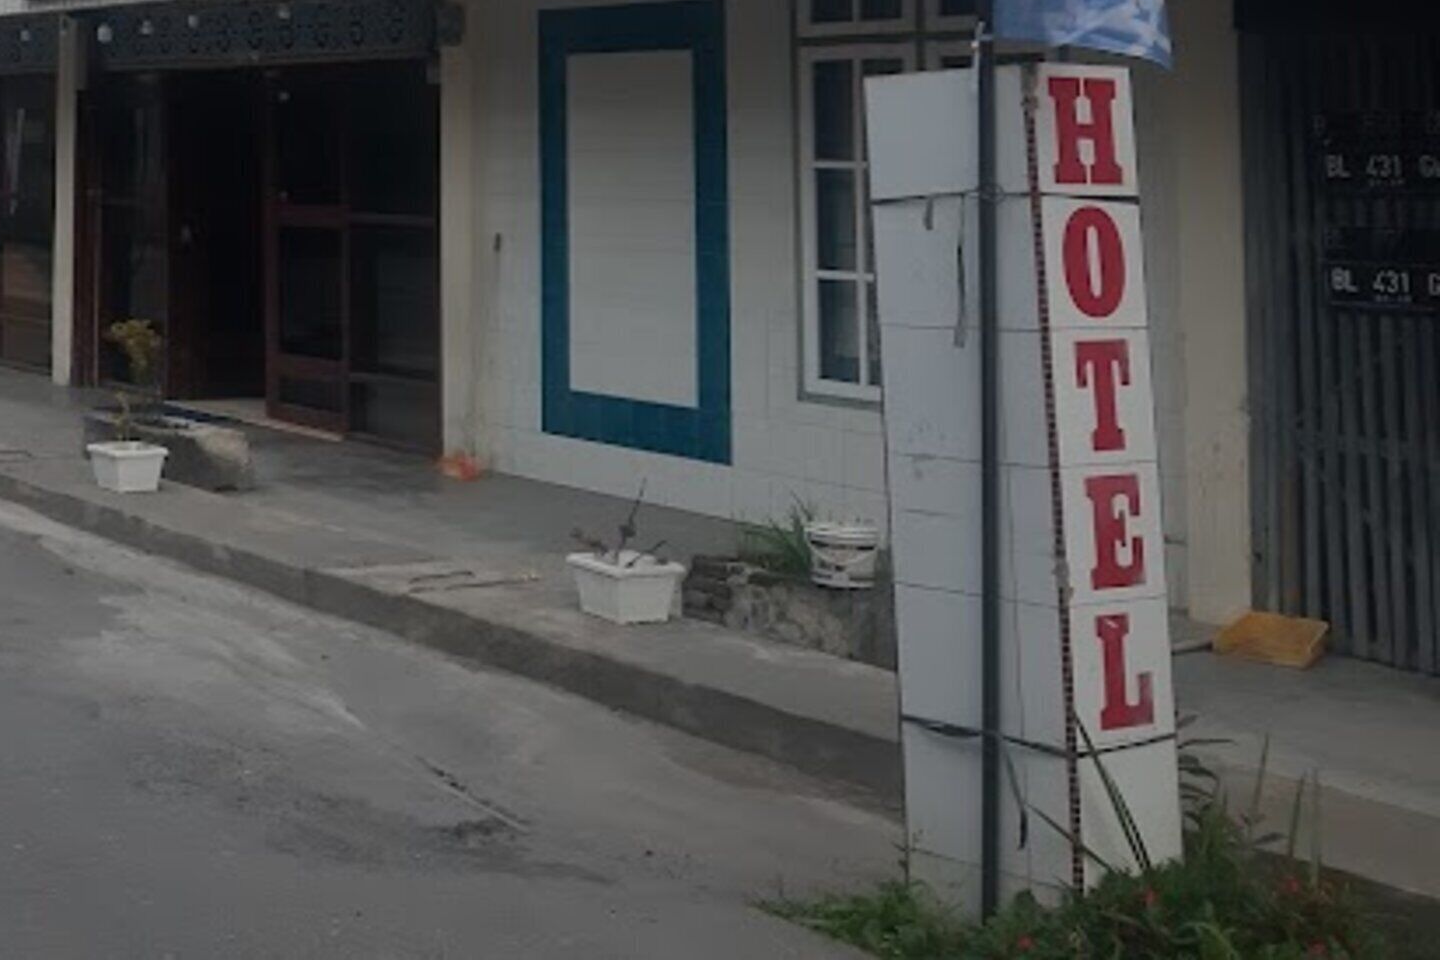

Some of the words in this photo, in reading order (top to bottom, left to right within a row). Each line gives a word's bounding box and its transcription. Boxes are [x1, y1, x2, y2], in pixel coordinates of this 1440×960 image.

[1364, 153, 1403, 178] 431
[1372, 267, 1411, 295] 431
[1046, 74, 1156, 733] HOTEL
